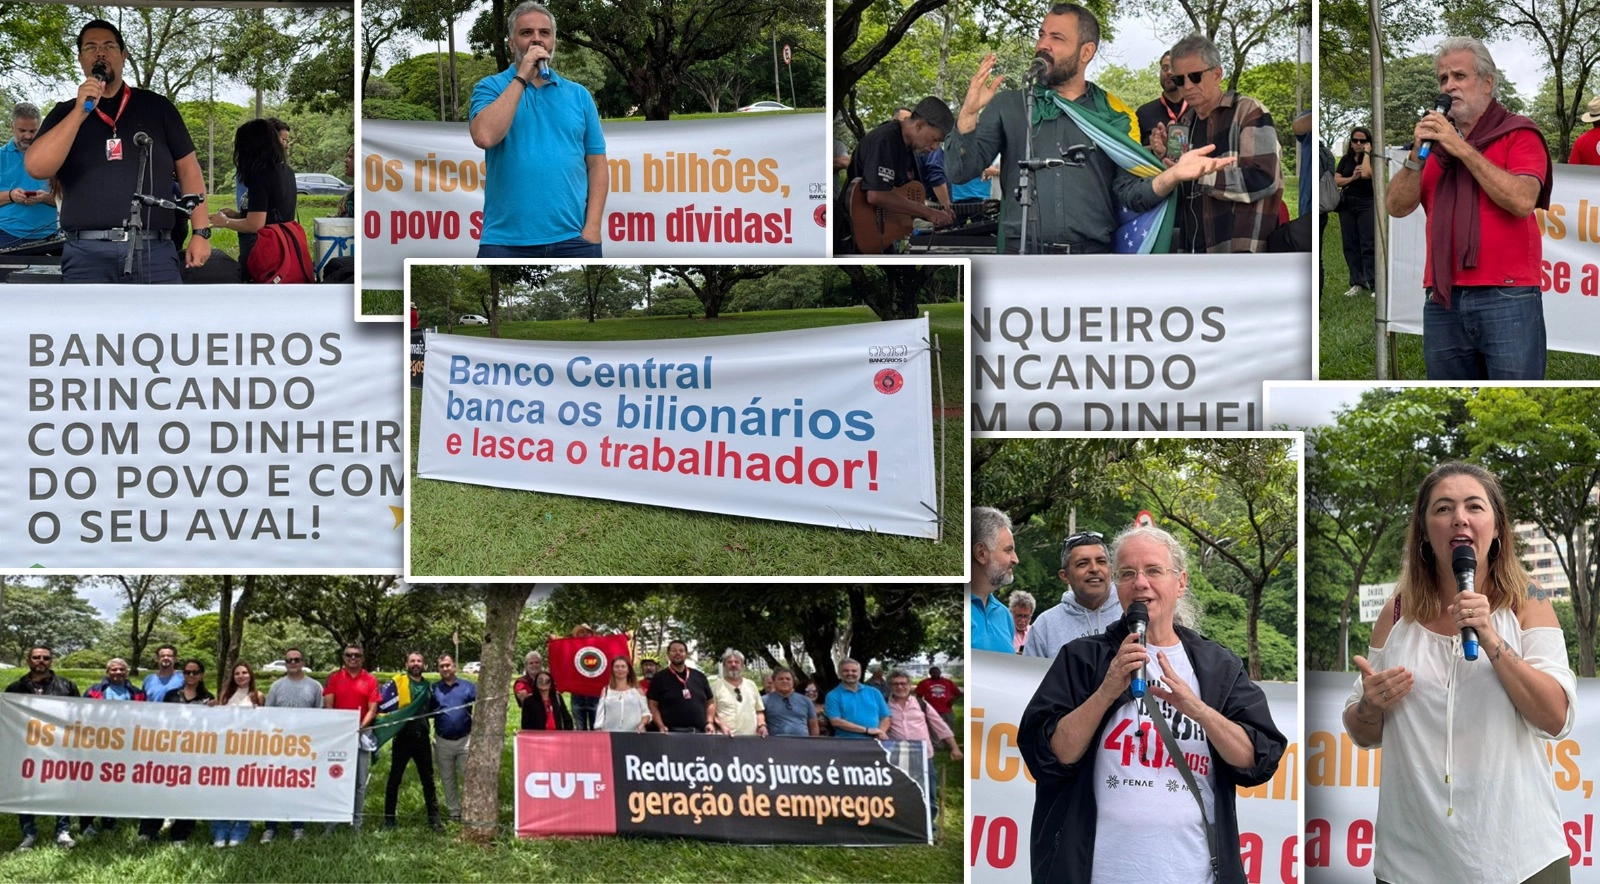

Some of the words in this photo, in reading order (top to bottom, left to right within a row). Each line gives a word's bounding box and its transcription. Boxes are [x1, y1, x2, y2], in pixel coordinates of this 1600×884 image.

[365, 153, 404, 193] Os
[643, 148, 791, 199] bilhões,
[364, 210, 381, 239] o
[391, 210, 460, 244] povo
[469, 210, 484, 240] s
[608, 211, 656, 242] em
[666, 203, 793, 244] dívidas!
[29, 332, 343, 374] BANQUEIROS
[975, 354, 1197, 390] NCANDO
[449, 355, 555, 387] Banco
[566, 356, 713, 390] Central
[29, 377, 315, 412] BRINCANDO
[446, 390, 545, 424] banca
[558, 400, 602, 427] os
[616, 394, 876, 442] bilionários
[28, 422, 139, 456] COM
[158, 421, 191, 455] O
[210, 420, 401, 454] DINHEIR
[446, 432, 462, 455] e
[472, 427, 554, 463] lasca
[566, 440, 588, 465] o
[599, 434, 879, 492] trabalhador!
[29, 467, 97, 500] DO
[117, 465, 249, 499] POVO
[268, 464, 290, 497] E
[309, 464, 404, 498] COM
[28, 511, 61, 544] O
[80, 509, 168, 543] SEU
[185, 505, 321, 541] AVAL!
[26, 719, 56, 747] Os
[62, 721, 126, 750] ricos
[131, 724, 218, 754] lucram
[224, 728, 317, 760] bilhões,
[1104, 718, 1164, 769] 40
[21, 758, 35, 779] o
[40, 759, 94, 783] povo
[100, 762, 126, 783] se
[131, 761, 192, 787] afoga
[198, 765, 230, 786] em
[236, 762, 317, 788] dívidas!
[524, 772, 602, 799] CUT
[625, 754, 723, 789] Redução
[727, 756, 766, 783] dos
[768, 757, 823, 791] juros
[826, 759, 840, 785] é
[843, 760, 893, 786] mais
[1123, 778, 1154, 788] FENAE
[628, 785, 734, 824] geração
[739, 785, 771, 817] de
[775, 794, 895, 826] empregos
